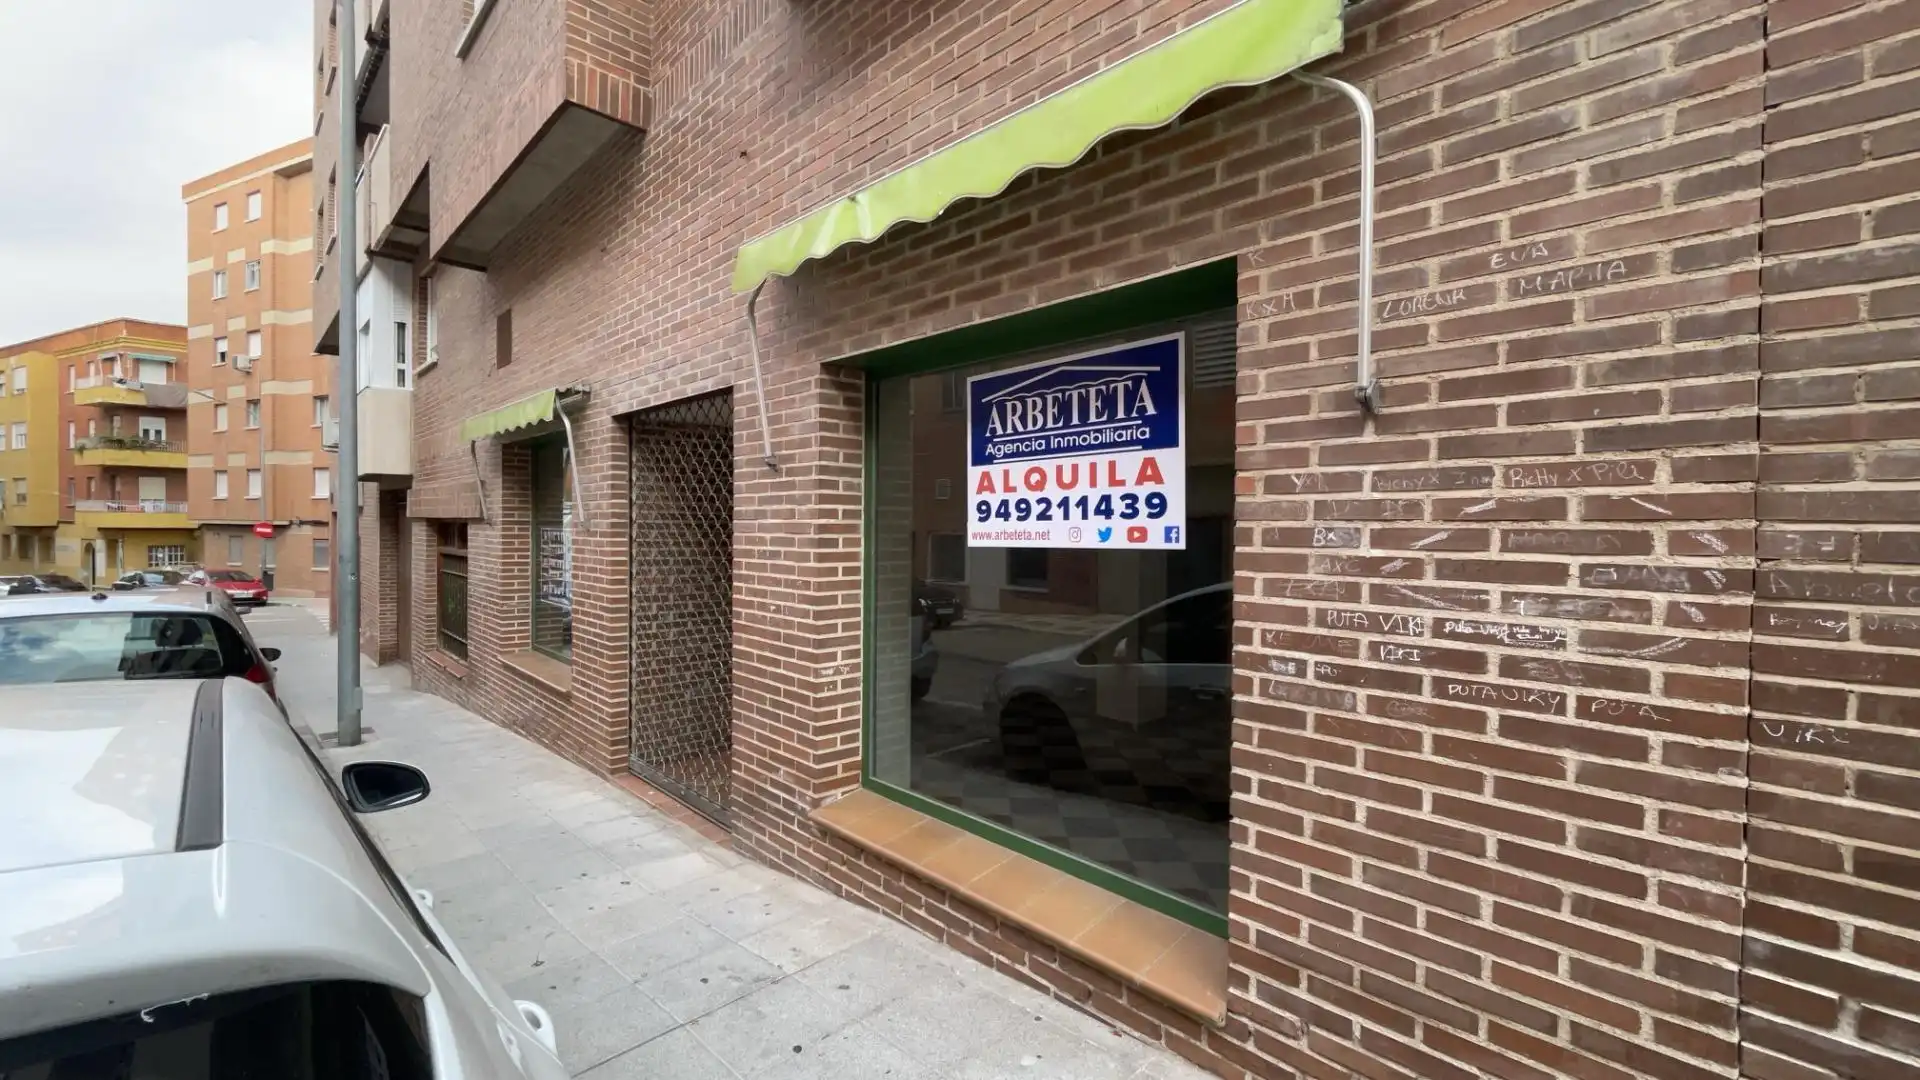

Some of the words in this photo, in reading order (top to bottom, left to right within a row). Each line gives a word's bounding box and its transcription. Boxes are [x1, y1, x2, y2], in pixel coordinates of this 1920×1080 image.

[985, 377, 1158, 438] ARBETETA
[985, 438, 1046, 458] Agencia
[1050, 424, 1150, 449] Inmobiliaria
[975, 456, 1165, 495] ALQUILA
[975, 491, 1168, 523] 949211439
[971, 527, 1051, 542] www.arbeteta.net
[1327, 609, 1370, 628] PUTA
[1448, 683, 1498, 700] PUTA
